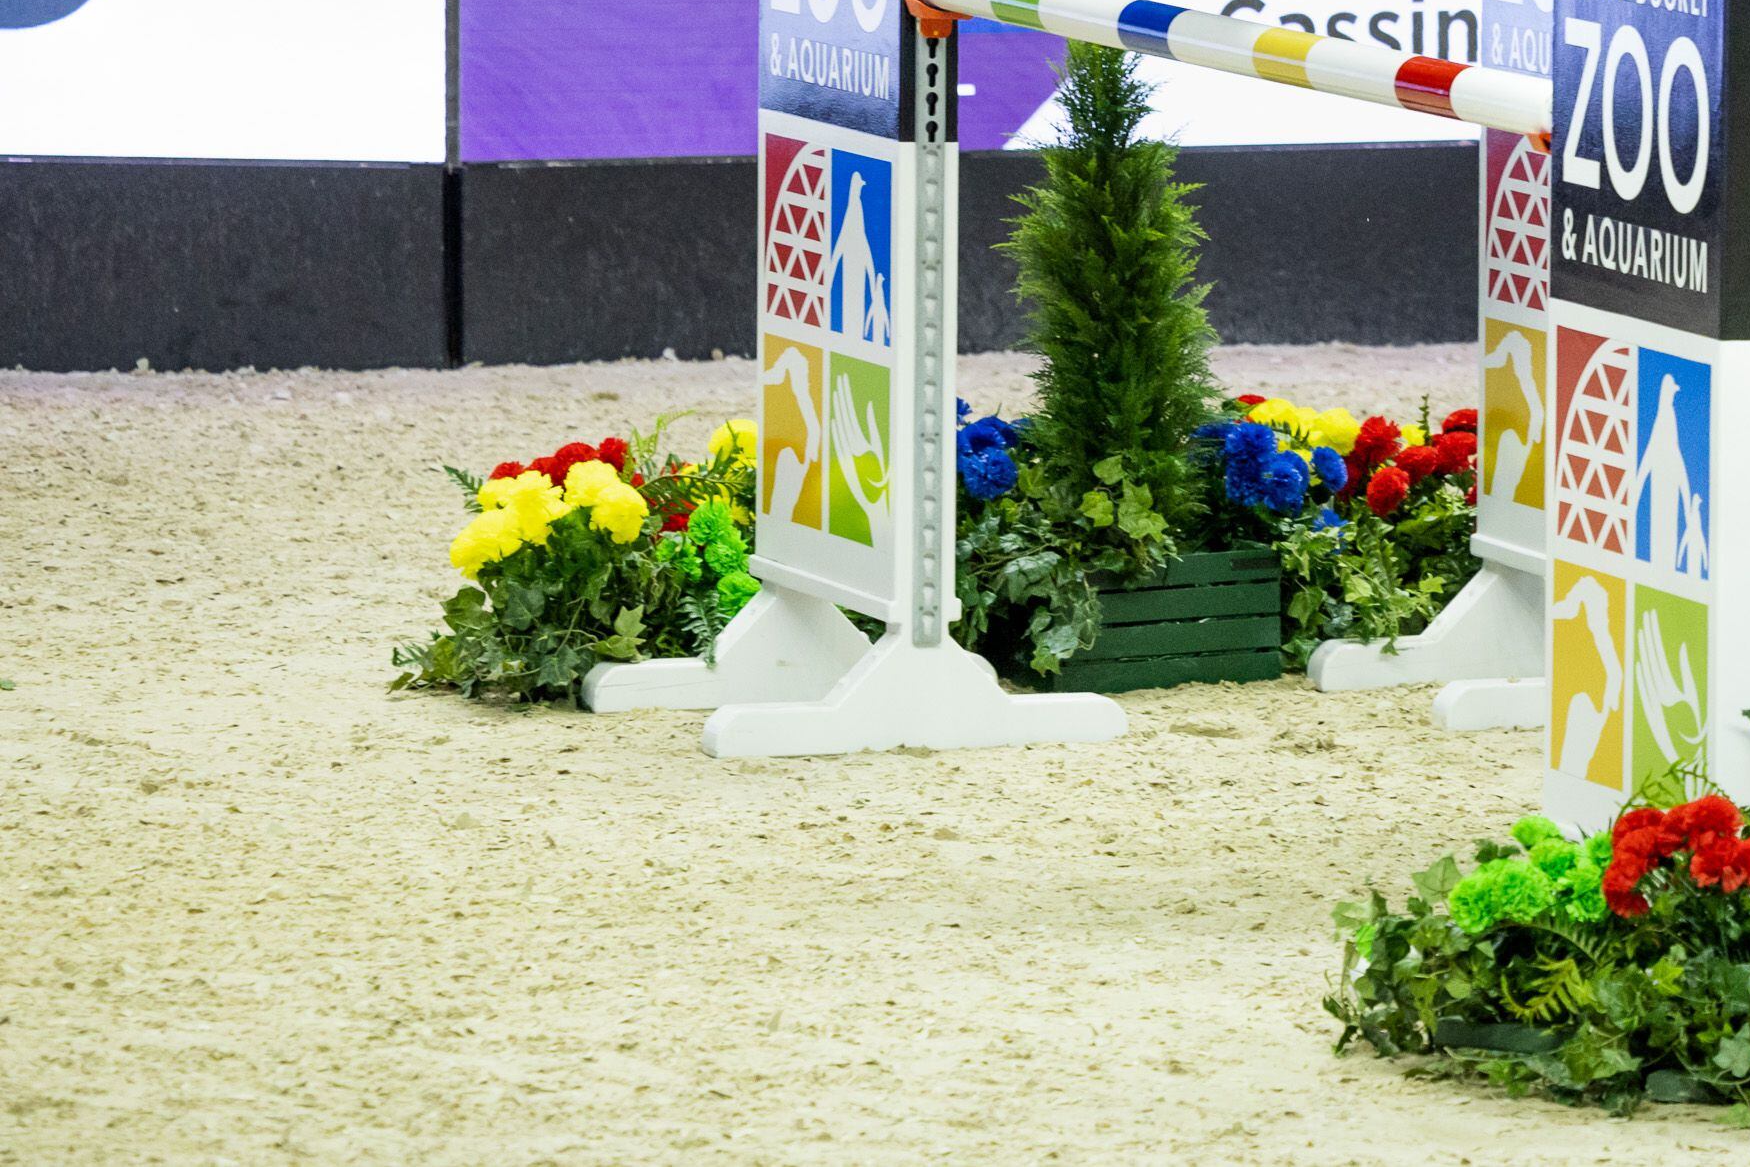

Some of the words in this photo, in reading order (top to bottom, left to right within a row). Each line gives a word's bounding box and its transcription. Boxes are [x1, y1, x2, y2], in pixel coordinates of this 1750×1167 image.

[769, 32, 782, 76] &
[787, 36, 890, 100] AQUARIUM
[1562, 16, 1710, 215] ZOO
[1562, 207, 1576, 260] &
[1582, 214, 1708, 294] AQUARIUM
